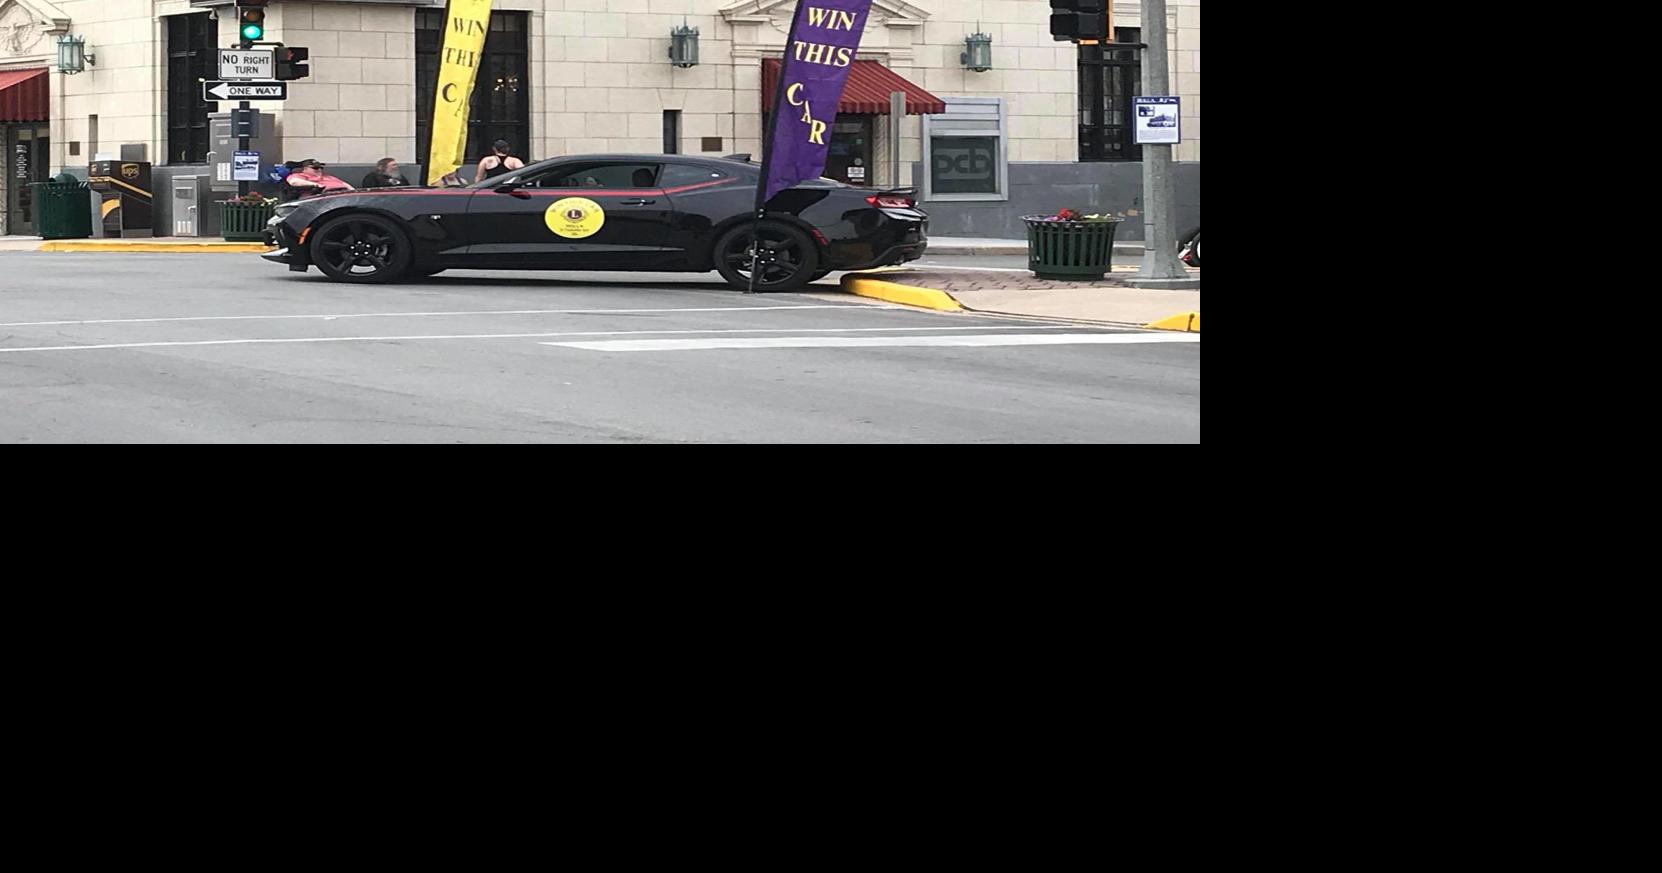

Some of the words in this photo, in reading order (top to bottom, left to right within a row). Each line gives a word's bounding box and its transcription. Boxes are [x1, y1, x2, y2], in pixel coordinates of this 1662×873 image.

[808, 7, 857, 31] WIN
[222, 54, 238, 64] NO
[243, 56, 270, 64] RIGHT
[444, 47, 475, 68] THI
[794, 41, 852, 67] THIS
[235, 66, 259, 74] TURN
[229, 87, 252, 95] ONE
[255, 87, 278, 95] WAY
[786, 82, 827, 145] CAR
